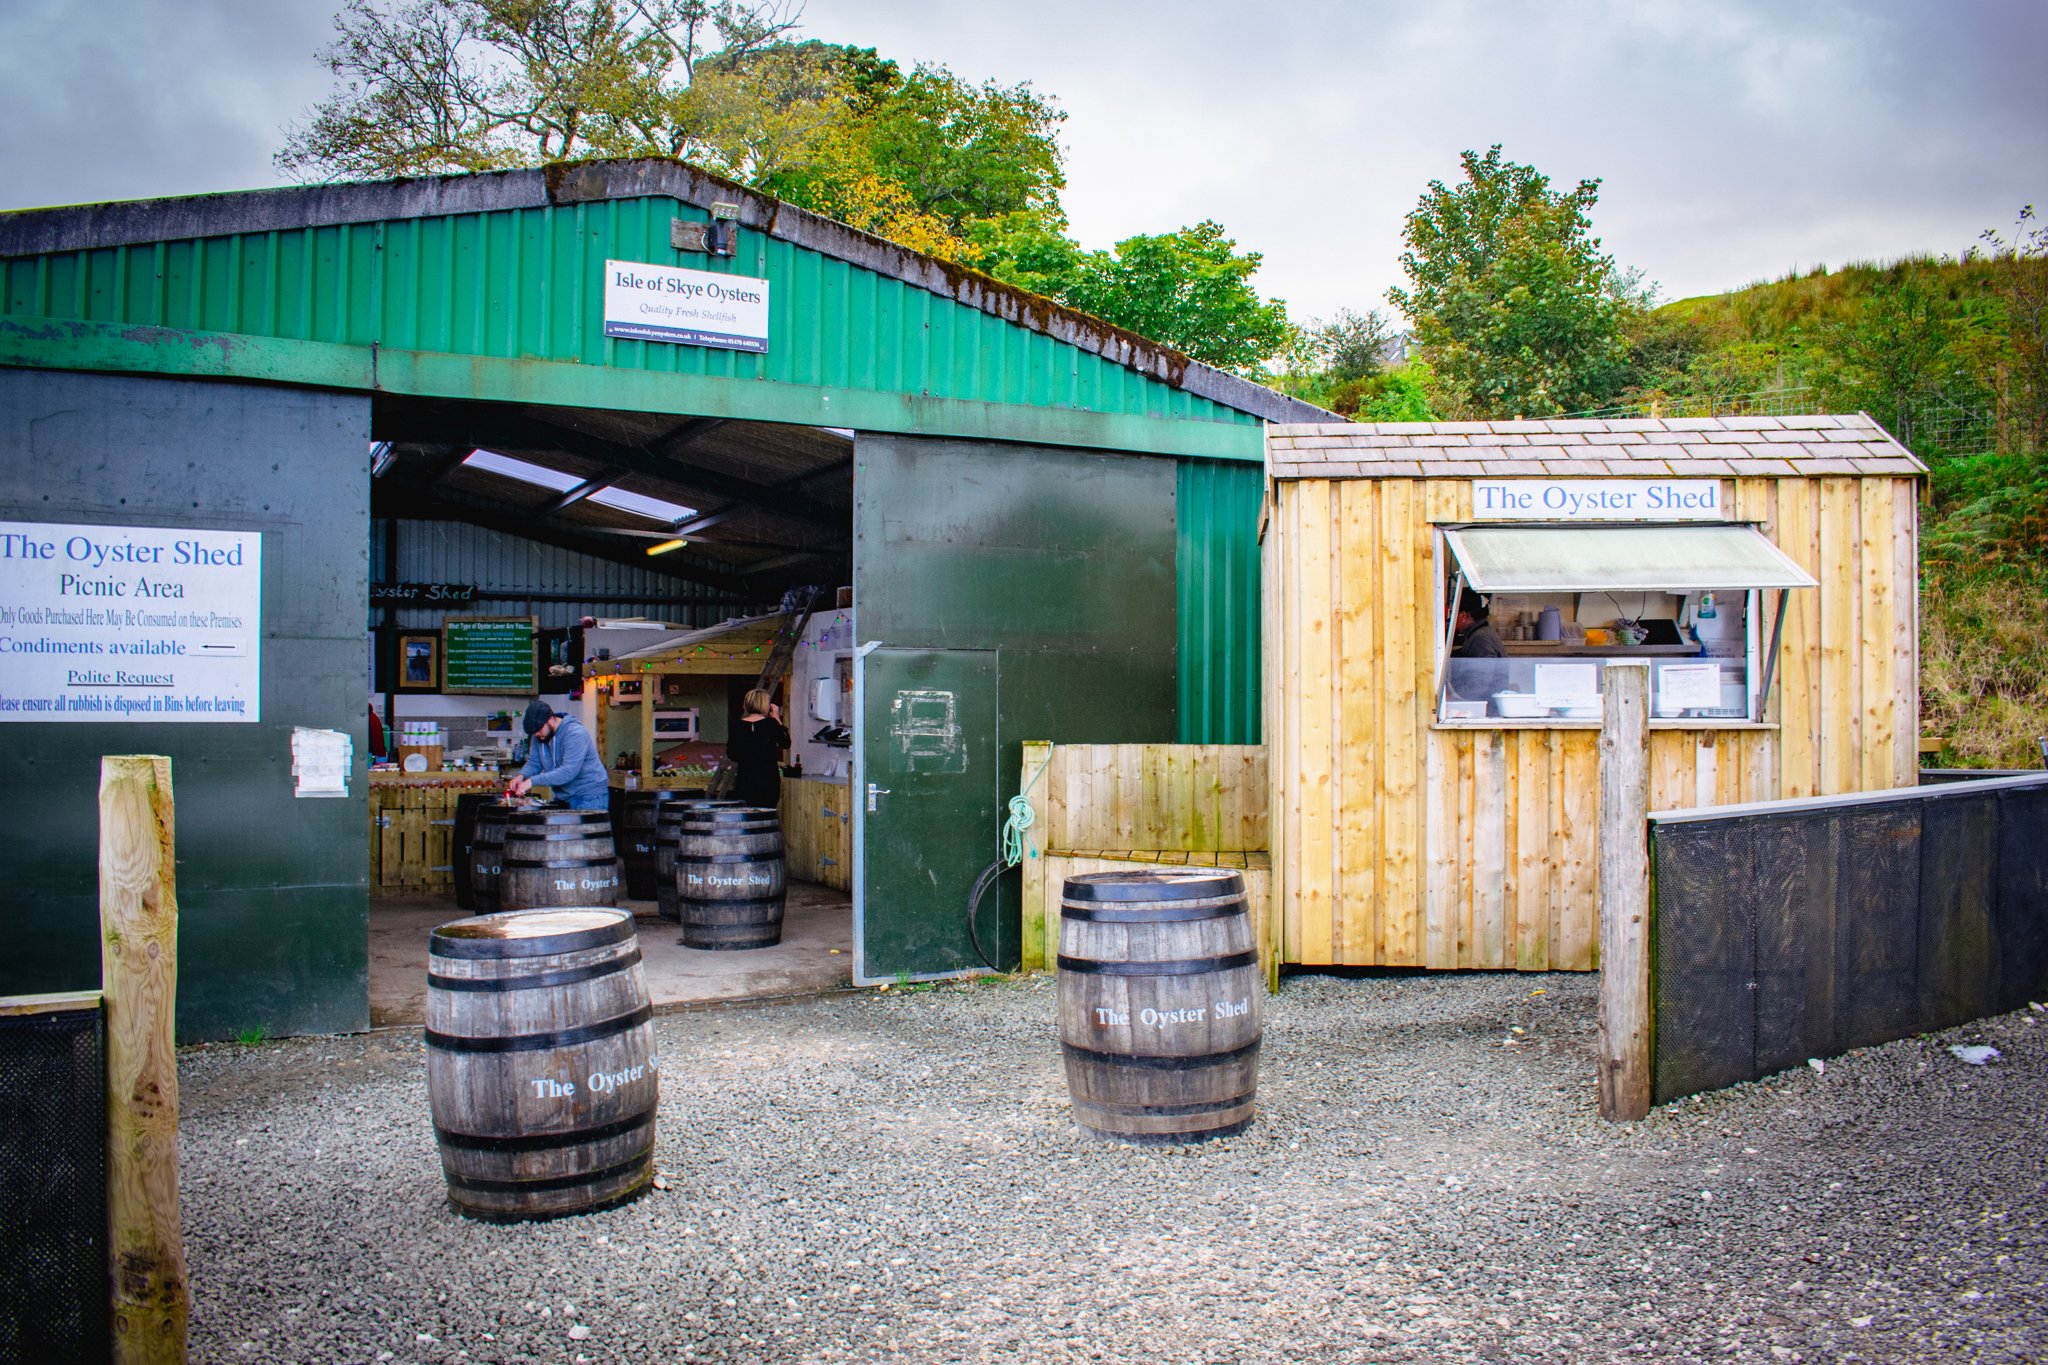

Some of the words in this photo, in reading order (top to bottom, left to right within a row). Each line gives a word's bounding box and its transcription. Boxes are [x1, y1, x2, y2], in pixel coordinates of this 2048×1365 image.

[616, 272, 643, 289] Isle
[647, 276, 664, 292] of
[666, 278, 704, 299] Skye
[707, 283, 761, 304] Oysters
[639, 303, 674, 317] Quality
[676, 306, 699, 318] Fresh
[702, 310, 736, 323] Shellfish
[1478, 486, 1534, 510] The
[1542, 486, 1637, 515] Oyster
[1646, 486, 1716, 510] Shed
[0, 534, 56, 560] The
[66, 536, 164, 568] Oyster
[173, 540, 244, 566] Shed
[60, 574, 127, 598] Picnic
[134, 577, 185, 598] Area
[424, 585, 474, 601] Shed
[18, 606, 43, 625] Goods
[45, 608, 84, 625] Purchased
[86, 608, 104, 626] Here
[106, 609, 124, 631] May
[126, 610, 136, 626] Be
[137, 610, 176, 627] Consumed
[178, 614, 188, 628] on
[190, 611, 208, 628] these
[210, 612, 242, 629] Premises
[477, 622, 492, 631] Oyster
[0, 636, 104, 655] Condiments
[109, 639, 186, 656] available
[68, 670, 111, 684] Polite
[116, 670, 174, 687] Request
[0, 694, 20, 712] lease
[22, 698, 52, 712] ensure
[54, 694, 66, 712] all
[68, 694, 102, 712] rubbish
[104, 695, 112, 712] is
[114, 695, 151, 716] disposed
[154, 696, 162, 712] in
[164, 696, 184, 712] Bins
[186, 695, 213, 712] before
[214, 696, 245, 716] leaving
[636, 843, 650, 853] The
[476, 864, 489, 874] The
[554, 879, 576, 890] The
[581, 879, 611, 892] Oyster
[688, 874, 704, 886] The
[708, 875, 744, 888] Oyster
[748, 874, 770, 886] Shed
[1096, 1007, 1130, 1026] The
[1140, 1006, 1207, 1030] Oyster
[1214, 998, 1248, 1020] Shed
[532, 1078, 575, 1100] The
[588, 1062, 644, 1095] Oyster
